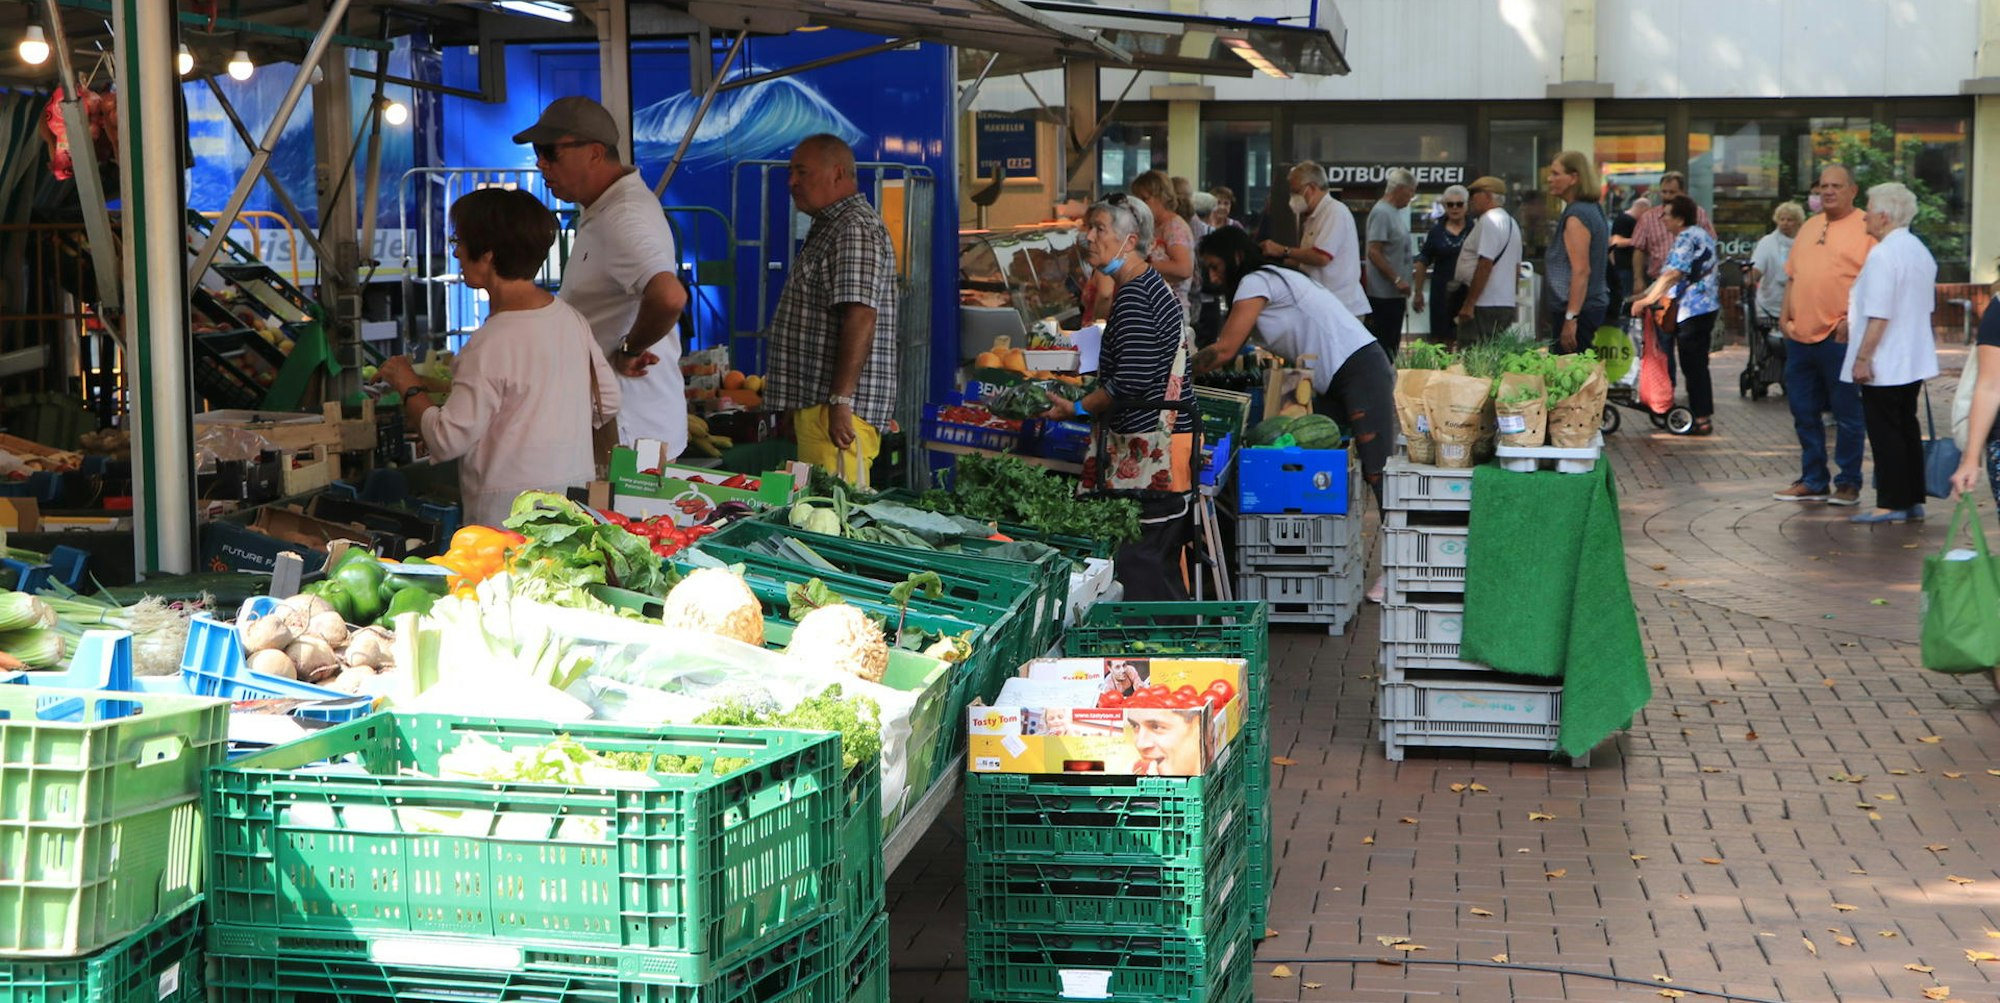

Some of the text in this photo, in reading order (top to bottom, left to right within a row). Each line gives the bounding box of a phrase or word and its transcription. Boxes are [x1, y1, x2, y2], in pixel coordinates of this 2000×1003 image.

[222, 544, 264, 564] FUTURE
[973, 715, 1018, 728] Tasty Tom
